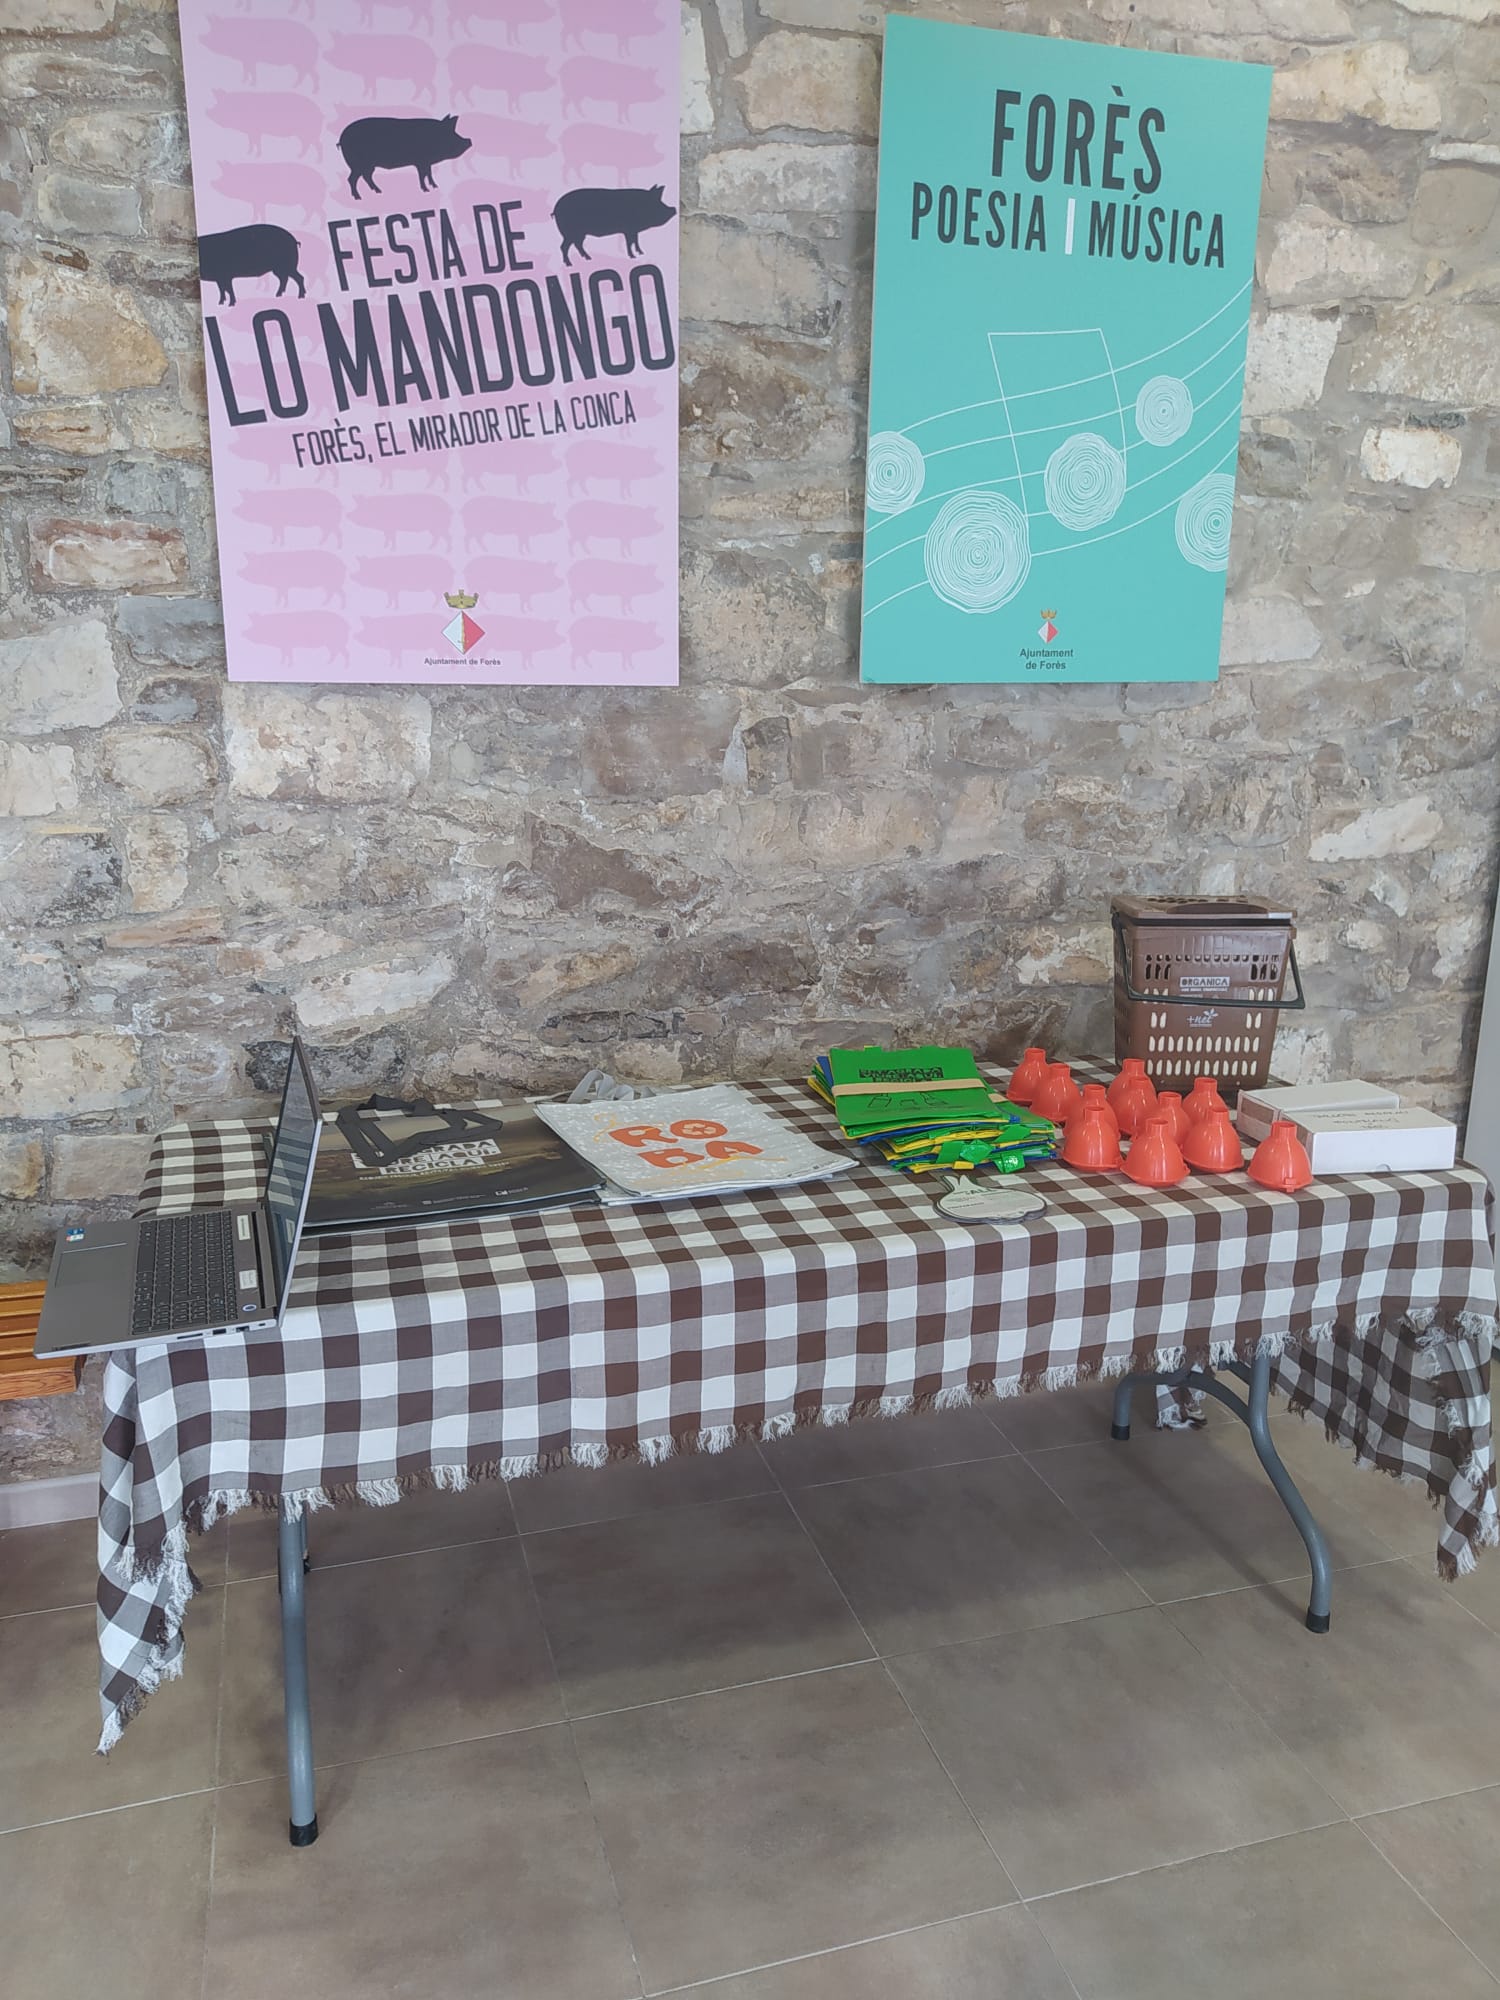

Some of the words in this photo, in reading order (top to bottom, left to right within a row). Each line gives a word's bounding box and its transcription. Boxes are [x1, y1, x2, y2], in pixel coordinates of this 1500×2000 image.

[990, 85, 1166, 194] FORÈS
[328, 208, 466, 291] FESTA
[474, 200, 533, 274] DE
[911, 182, 1047, 252] POESIA
[1088, 194, 1225, 268] MÚSICA
[205, 308, 309, 427] LO
[317, 263, 676, 412] MANDONGO
[292, 419, 374, 468] FORÈS,
[376, 423, 406, 458] EL
[408, 408, 503, 453] MIRADOR
[505, 404, 536, 439] DE
[538, 401, 568, 435] LA
[570, 390, 637, 431] CONCA
[424, 657, 467, 666] Ajuntament
[1020, 648, 1073, 660] Ajuntament
[1025, 660, 1037, 670] de
[385, 1157, 479, 1173] RECICLA
